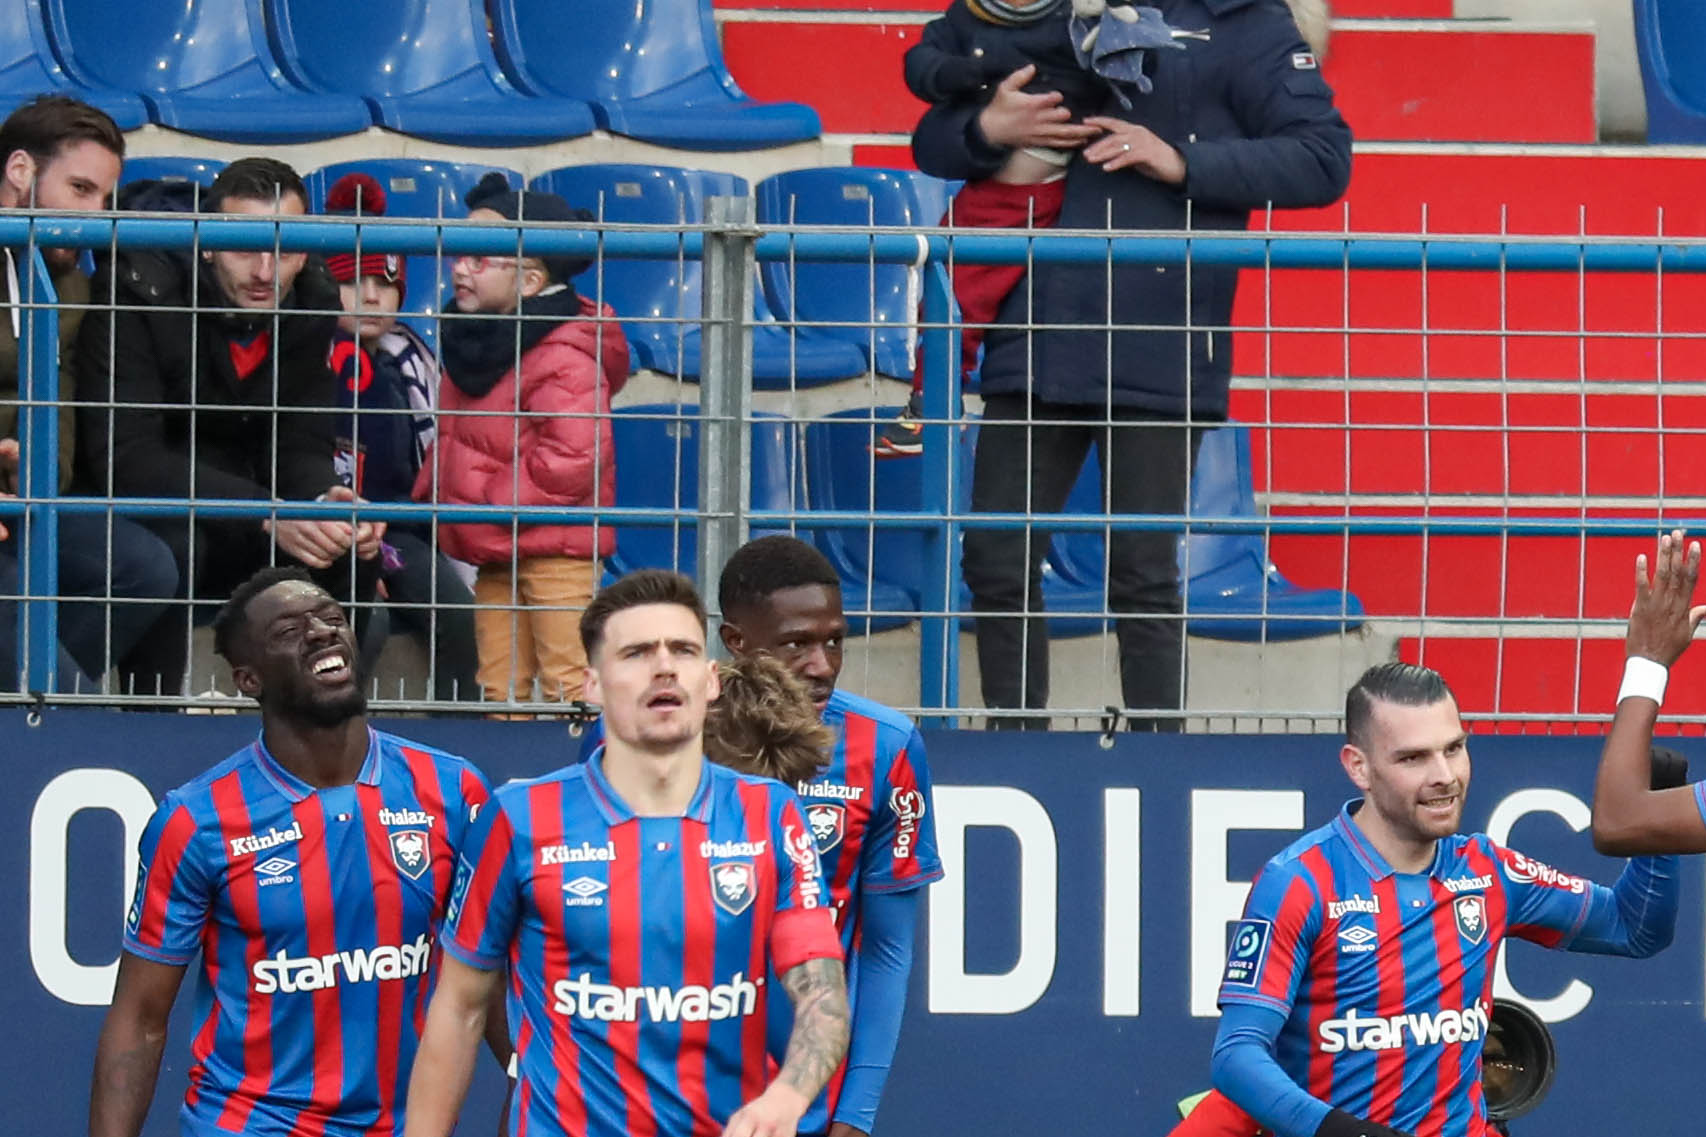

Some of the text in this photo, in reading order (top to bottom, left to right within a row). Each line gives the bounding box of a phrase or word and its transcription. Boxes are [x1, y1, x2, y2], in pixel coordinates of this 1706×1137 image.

[797, 779, 865, 801] thalazur
[378, 807, 436, 828] thalazr
[230, 821, 304, 856] Künkel
[700, 839, 767, 859] thalazur
[541, 841, 617, 866] Künkel
[258, 873, 294, 887] umbro
[1443, 874, 1494, 893] thalazur
[565, 896, 604, 907] umbro
[1341, 943, 1377, 954] umbro
[252, 932, 432, 995] starwash
[553, 971, 758, 1023] starwash
[1319, 996, 1489, 1053] starwash
